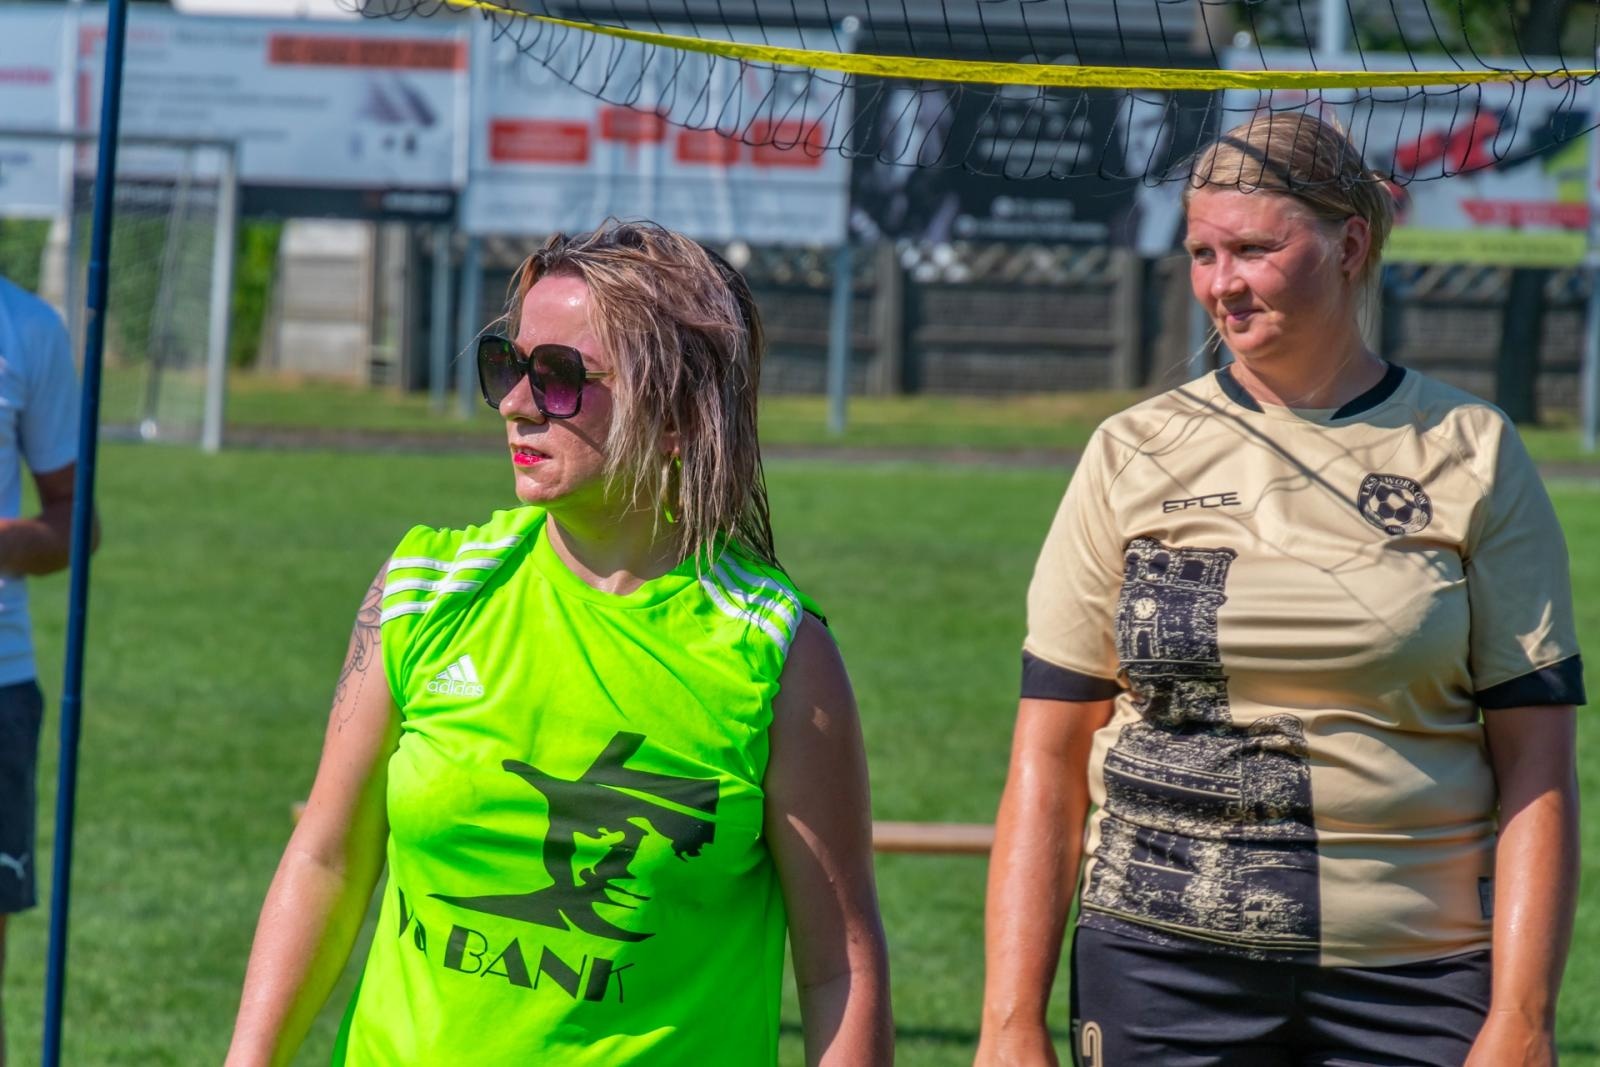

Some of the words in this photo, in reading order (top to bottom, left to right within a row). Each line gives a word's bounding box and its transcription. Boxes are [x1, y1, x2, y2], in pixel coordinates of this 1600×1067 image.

[1162, 491, 1242, 514] EFCE
[427, 680, 485, 699] adidas
[443, 923, 635, 1003] BANK
